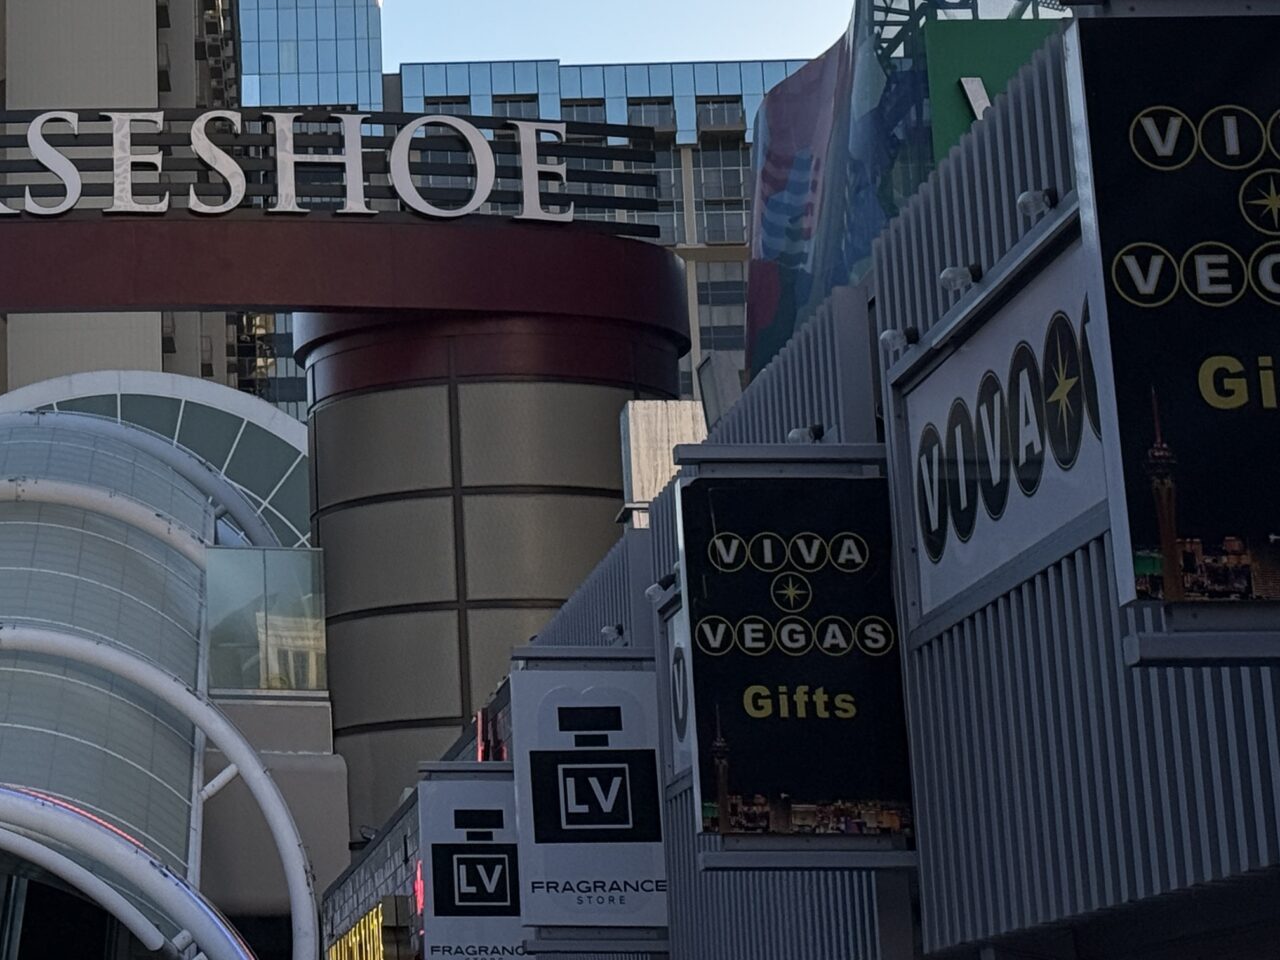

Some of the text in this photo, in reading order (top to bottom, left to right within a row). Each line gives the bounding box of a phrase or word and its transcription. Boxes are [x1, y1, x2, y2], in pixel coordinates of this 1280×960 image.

[1197, 354, 1279, 410] Gi
[918, 365, 1044, 535] VIVA
[713, 537, 865, 565] VIVA
[699, 622, 887, 650] VEGAS
[742, 683, 858, 720] Gifts
[565, 776, 623, 814] LV
[458, 864, 504, 894] LV
[531, 879, 668, 895] FRAGRANCE
[576, 895, 627, 906] STORE
